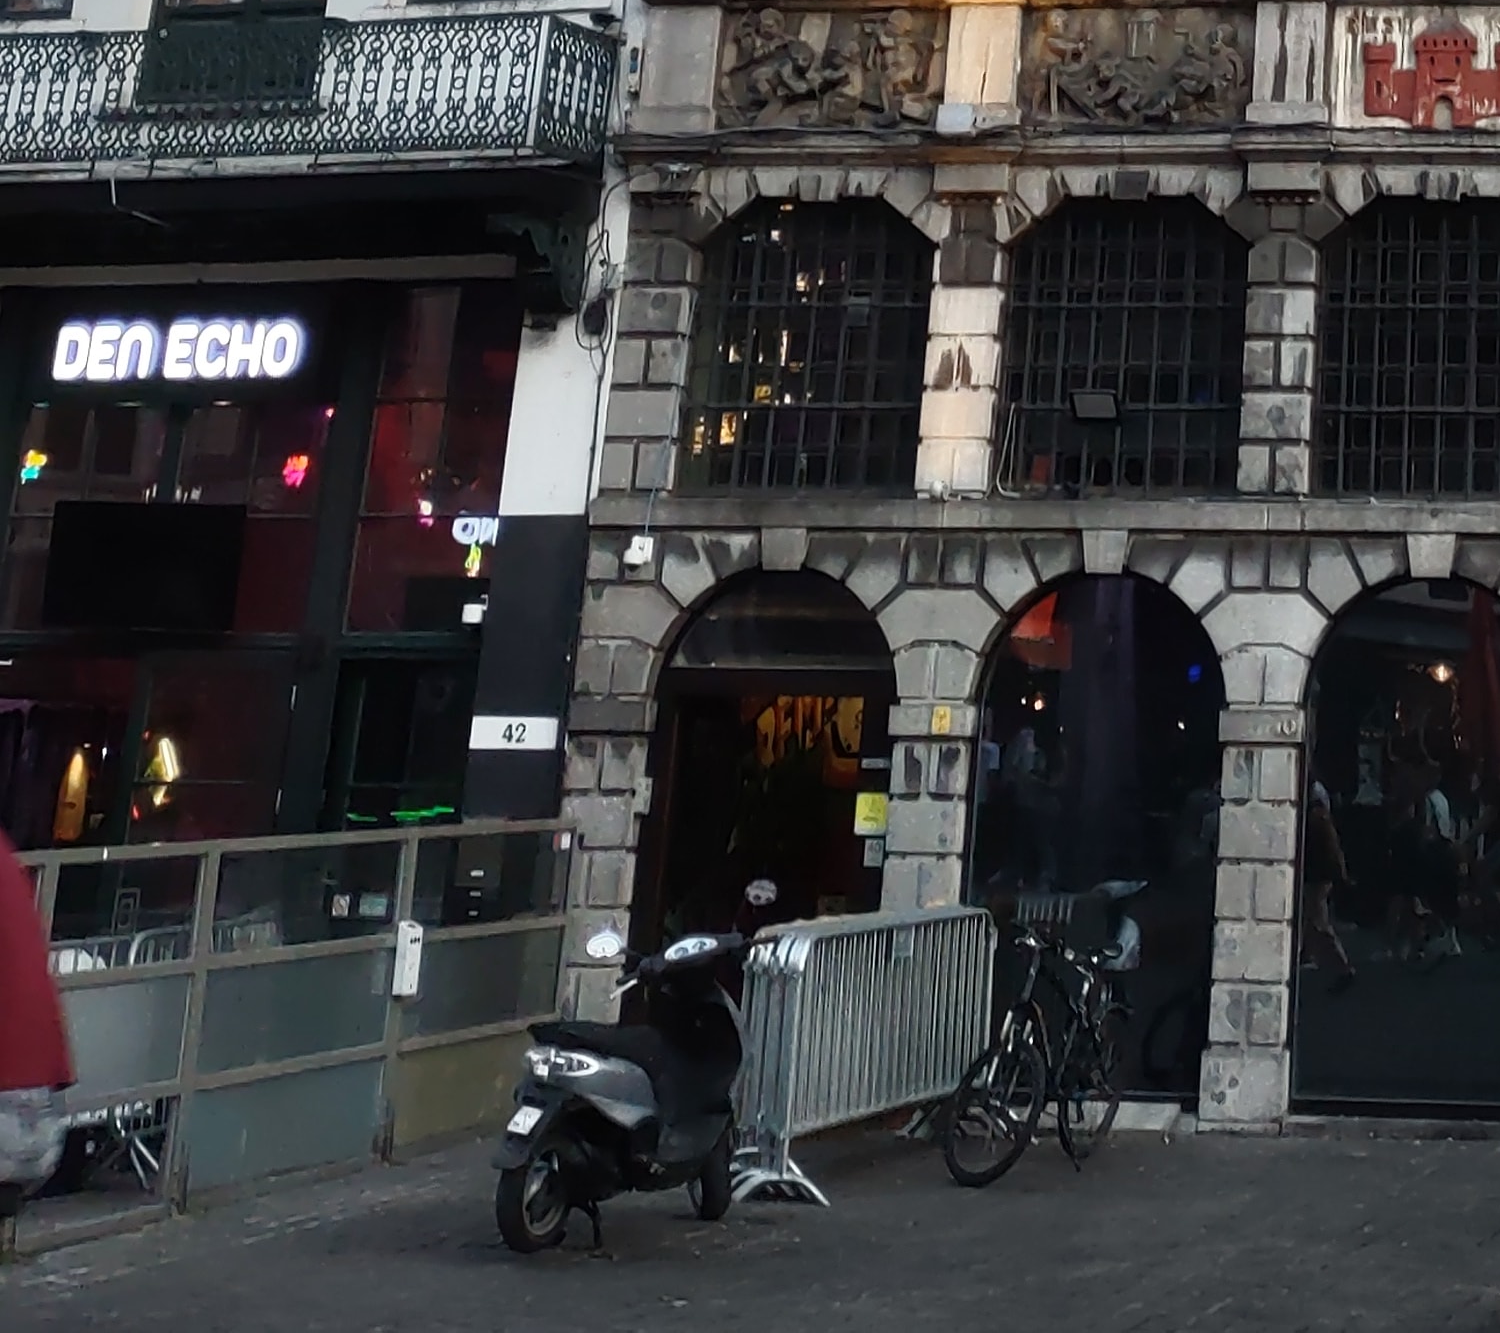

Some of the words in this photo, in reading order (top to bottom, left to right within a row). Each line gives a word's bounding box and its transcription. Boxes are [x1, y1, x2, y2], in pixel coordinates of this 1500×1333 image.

[52, 324, 155, 381] DEN
[162, 322, 299, 379] ECHO
[502, 722, 527, 744] 42
